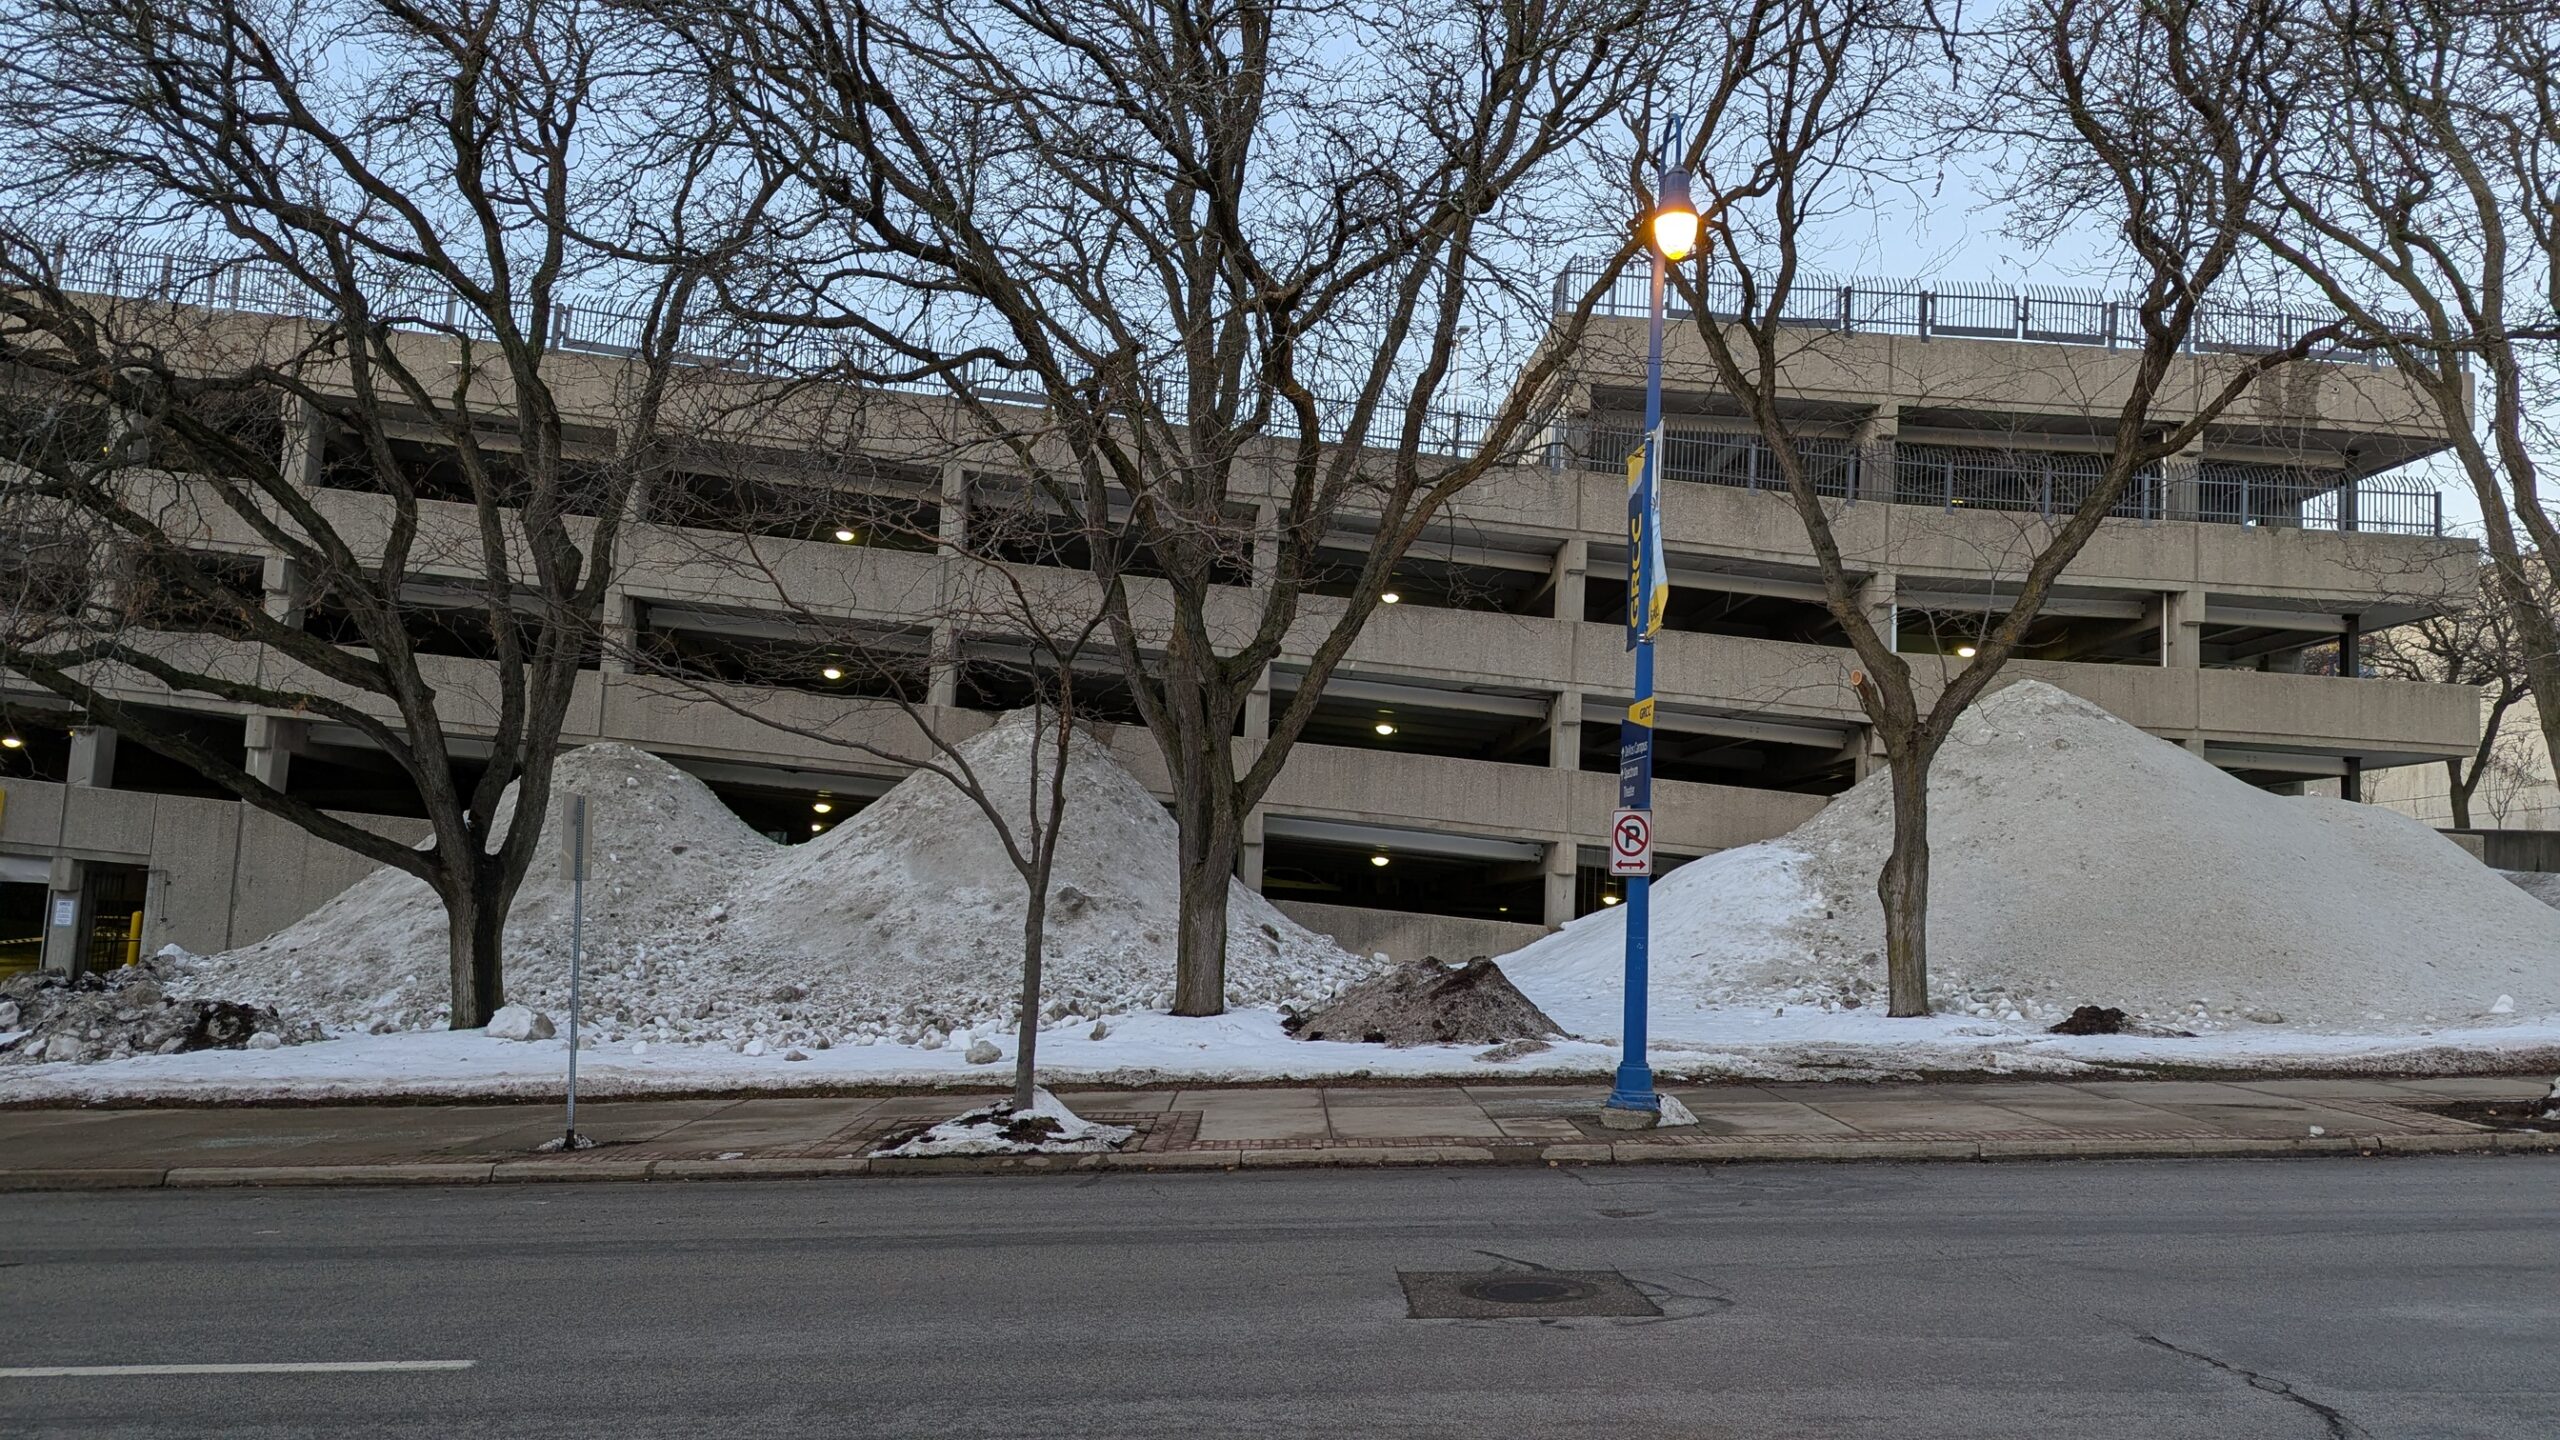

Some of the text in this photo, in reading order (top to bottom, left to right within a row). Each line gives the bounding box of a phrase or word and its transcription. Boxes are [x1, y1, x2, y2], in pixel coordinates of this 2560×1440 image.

[1630, 513, 1642, 629] GRCC
[1640, 705, 1652, 720] GRCC
[1625, 826, 1640, 848] P
